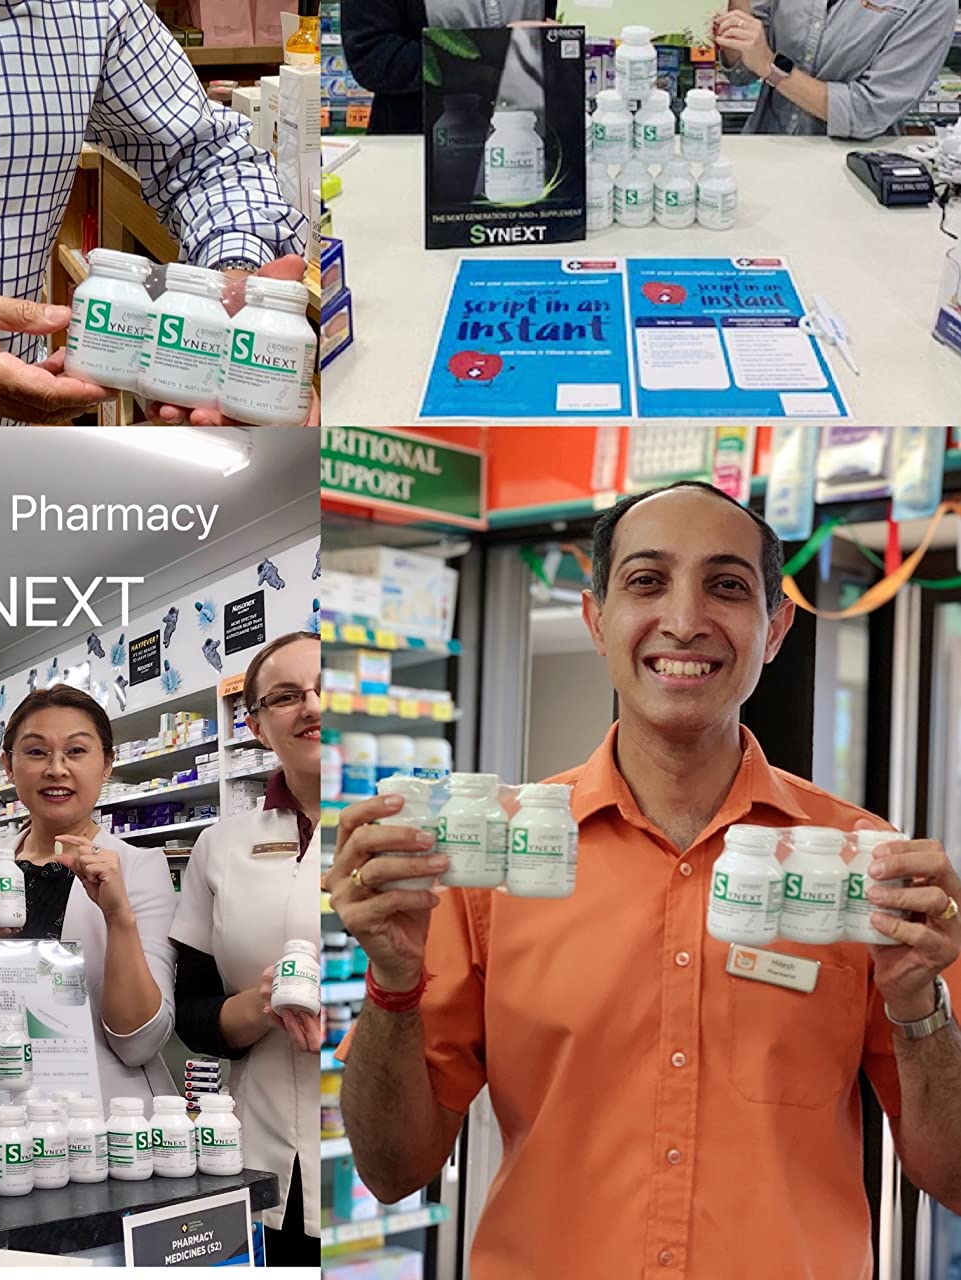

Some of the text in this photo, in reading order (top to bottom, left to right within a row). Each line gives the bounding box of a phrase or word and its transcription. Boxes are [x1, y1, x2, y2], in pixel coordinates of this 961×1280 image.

[470, 224, 547, 244] SYNEXT
[745, 282, 759, 291] in
[768, 283, 782, 291] an
[463, 295, 610, 319] script in an
[701, 293, 785, 308] instant
[456, 314, 609, 343] instant
[172, 1231, 214, 1250] PHARMACY
[165, 1241, 222, 1265] MEDICINES (S2)
